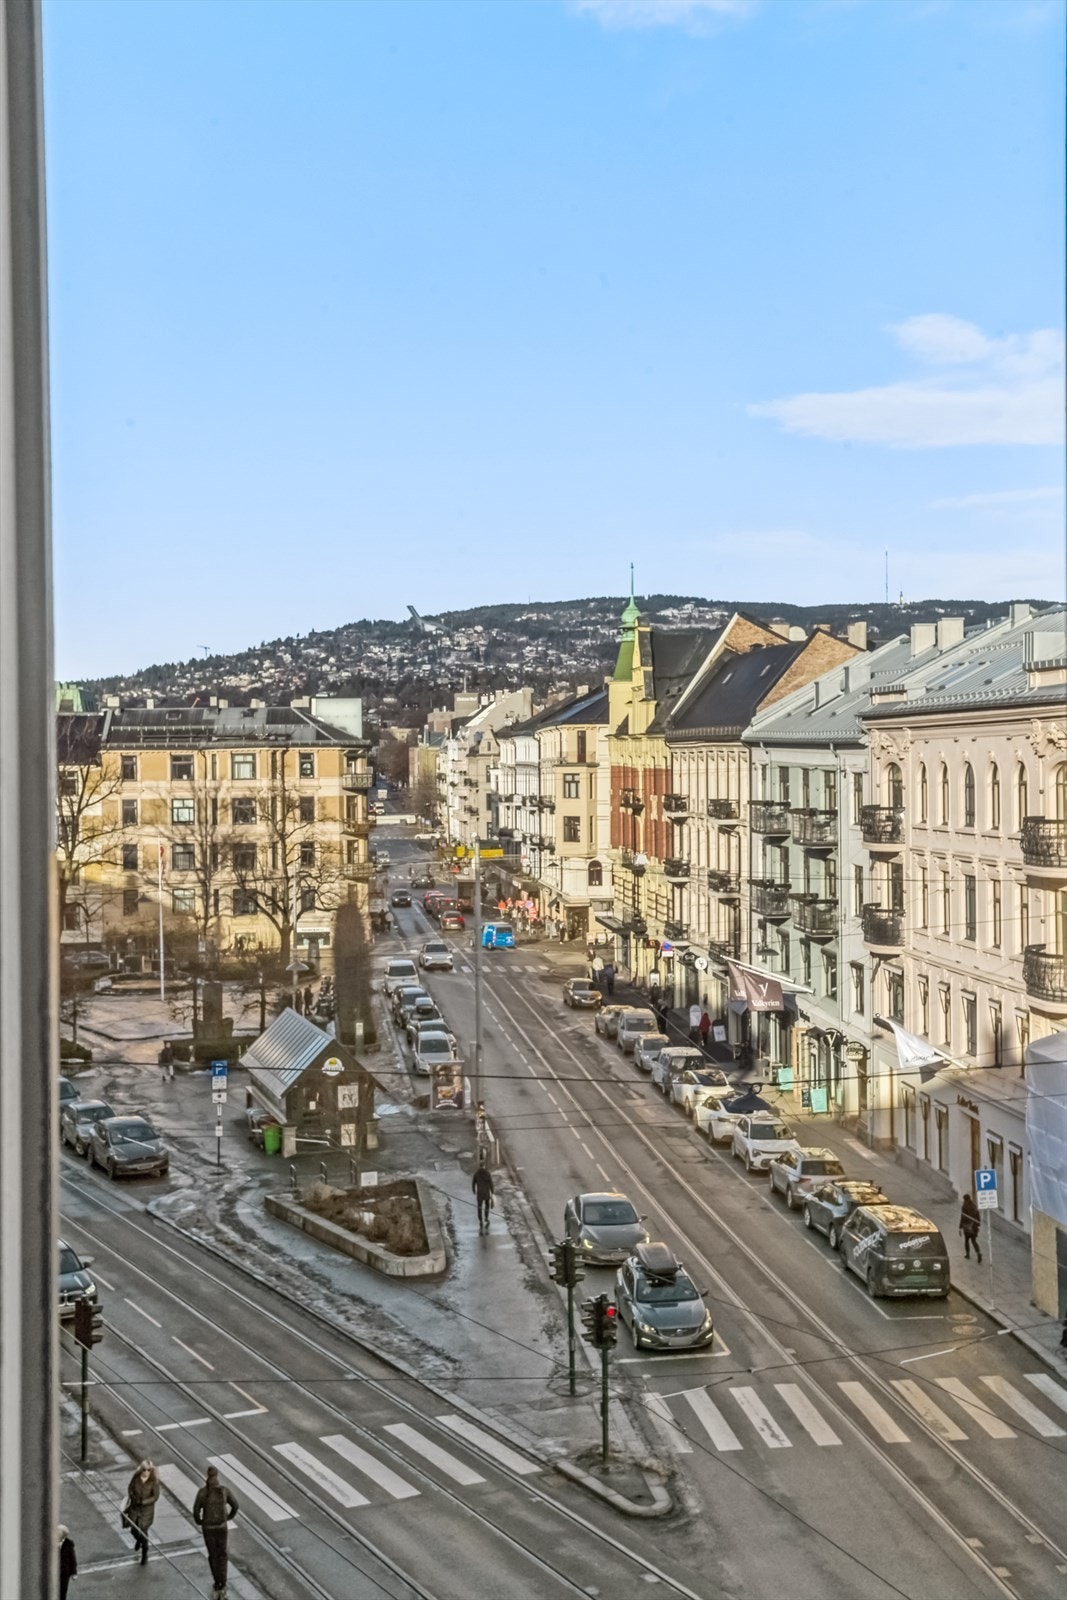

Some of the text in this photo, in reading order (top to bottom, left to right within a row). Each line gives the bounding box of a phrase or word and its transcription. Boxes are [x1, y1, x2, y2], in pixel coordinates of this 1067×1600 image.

[751, 999, 780, 1009] Valkyrien
[215, 1063, 225, 1075] P
[980, 1172, 992, 1189] P
